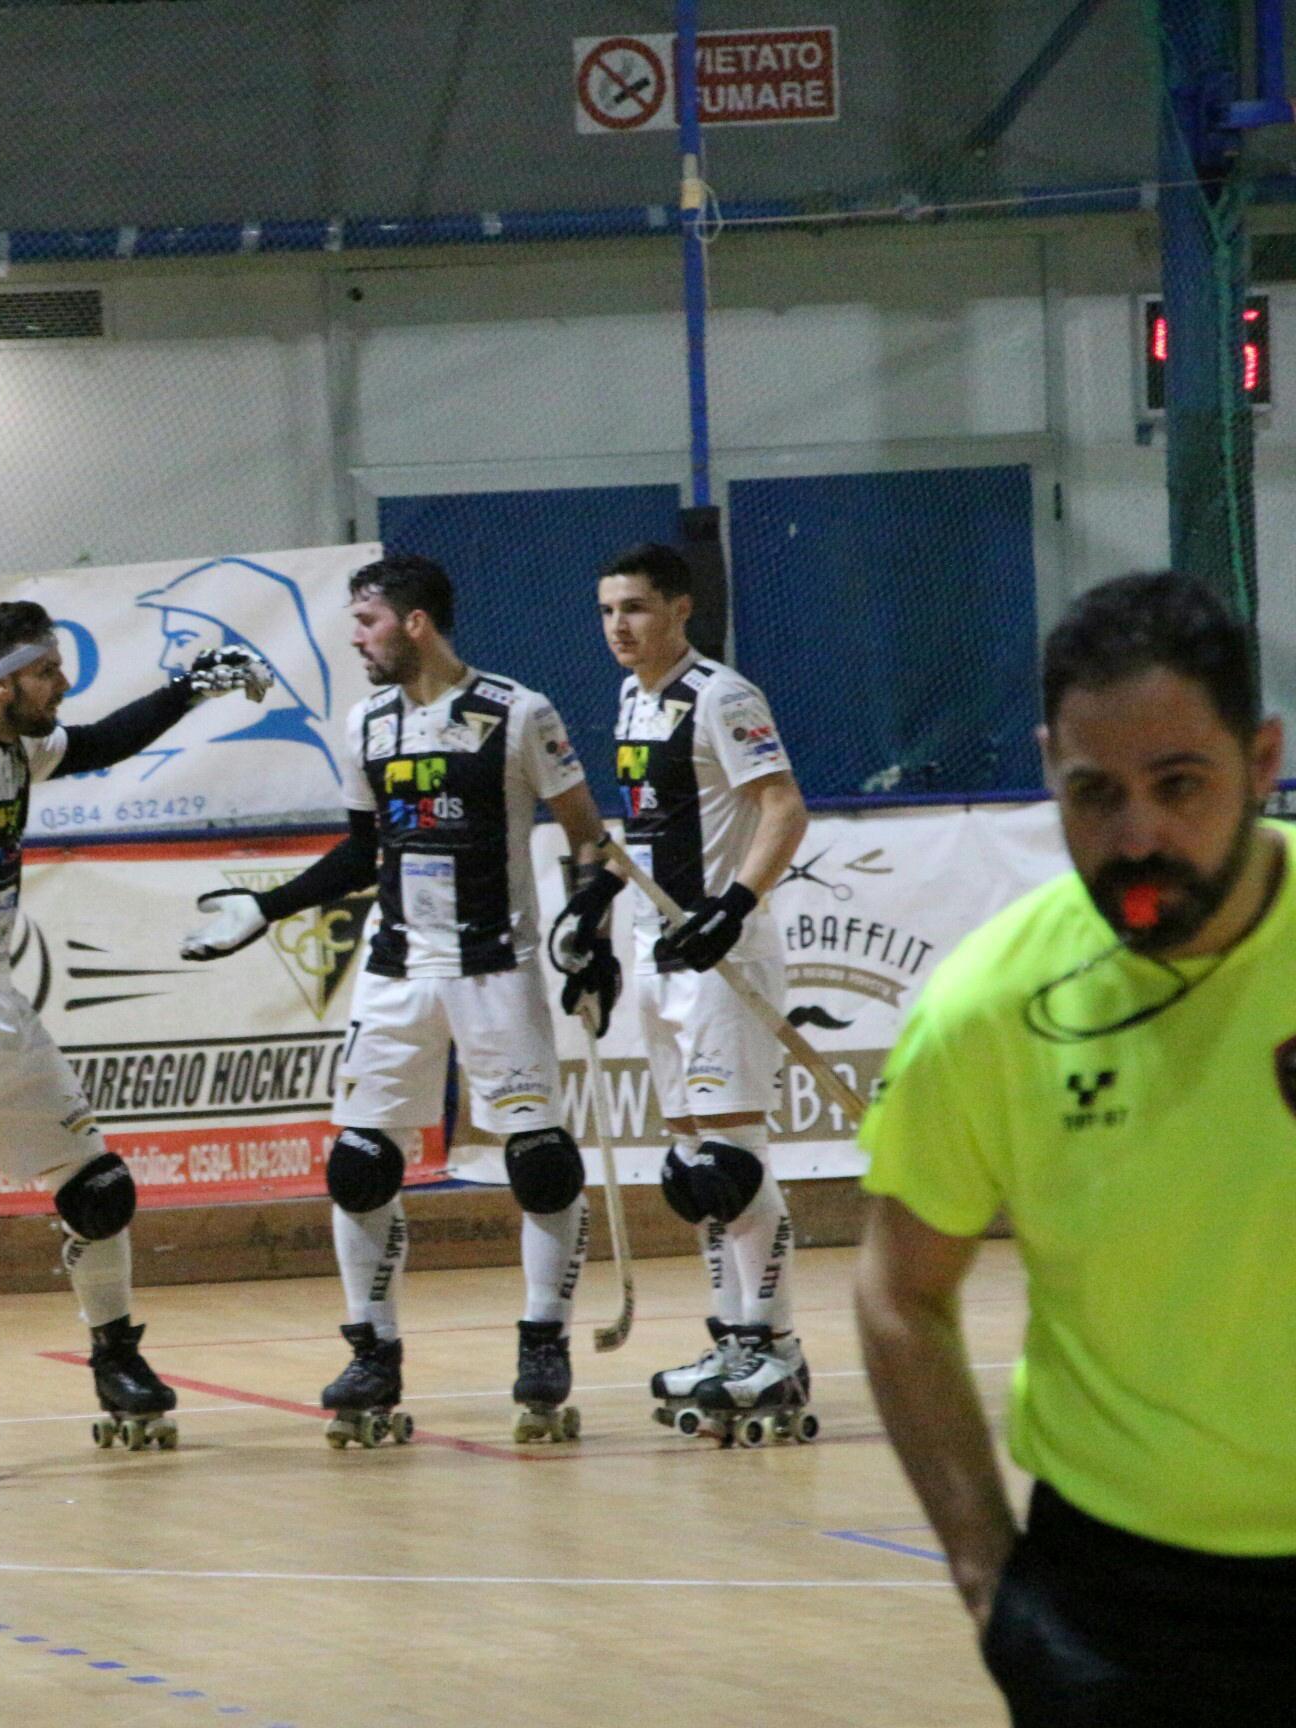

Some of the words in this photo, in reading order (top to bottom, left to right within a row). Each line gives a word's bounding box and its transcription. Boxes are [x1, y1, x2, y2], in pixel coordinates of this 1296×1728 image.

[40, 805, 101, 829] 0584
[115, 795, 206, 821] 632429
[68, 1053, 208, 1111] IAREGGIO
[209, 1045, 326, 1103] HOCKEY
[369, 1264, 394, 1302] ELLE
[758, 1253, 782, 1299] ELLE
